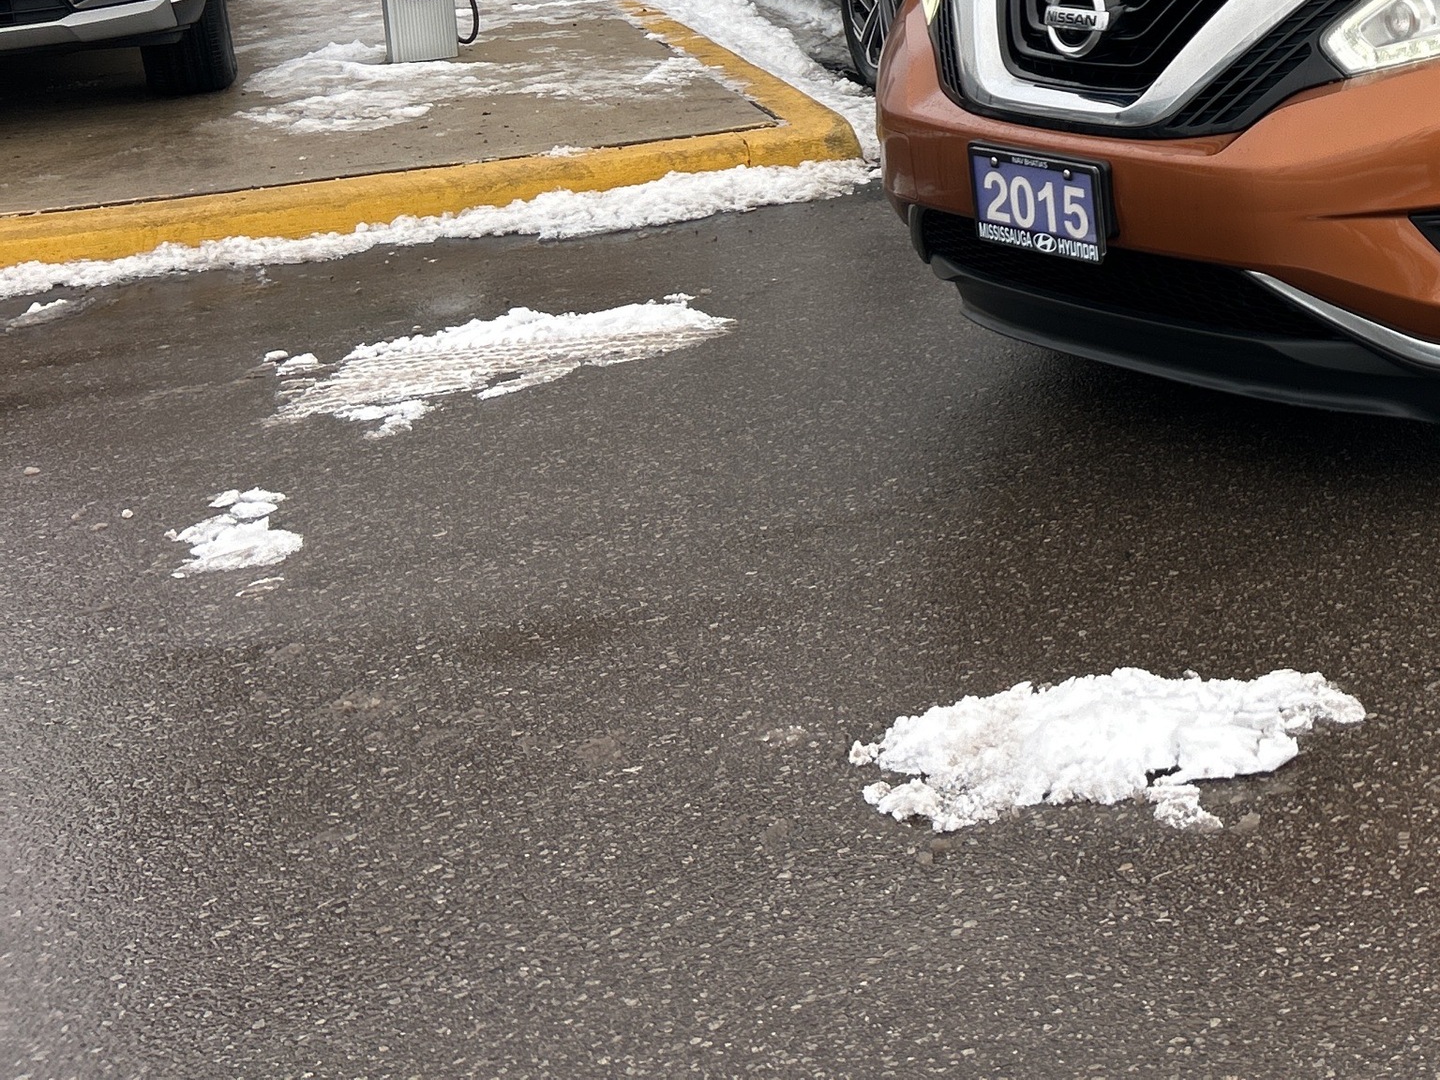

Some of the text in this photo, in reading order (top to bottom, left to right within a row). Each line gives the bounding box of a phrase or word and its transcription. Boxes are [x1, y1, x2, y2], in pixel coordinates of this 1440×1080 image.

[1047, 10, 1097, 26] NISSAN
[983, 171, 1089, 239] 2015
[978, 221, 1099, 261] MISSISSAUGA HYUNDAI
